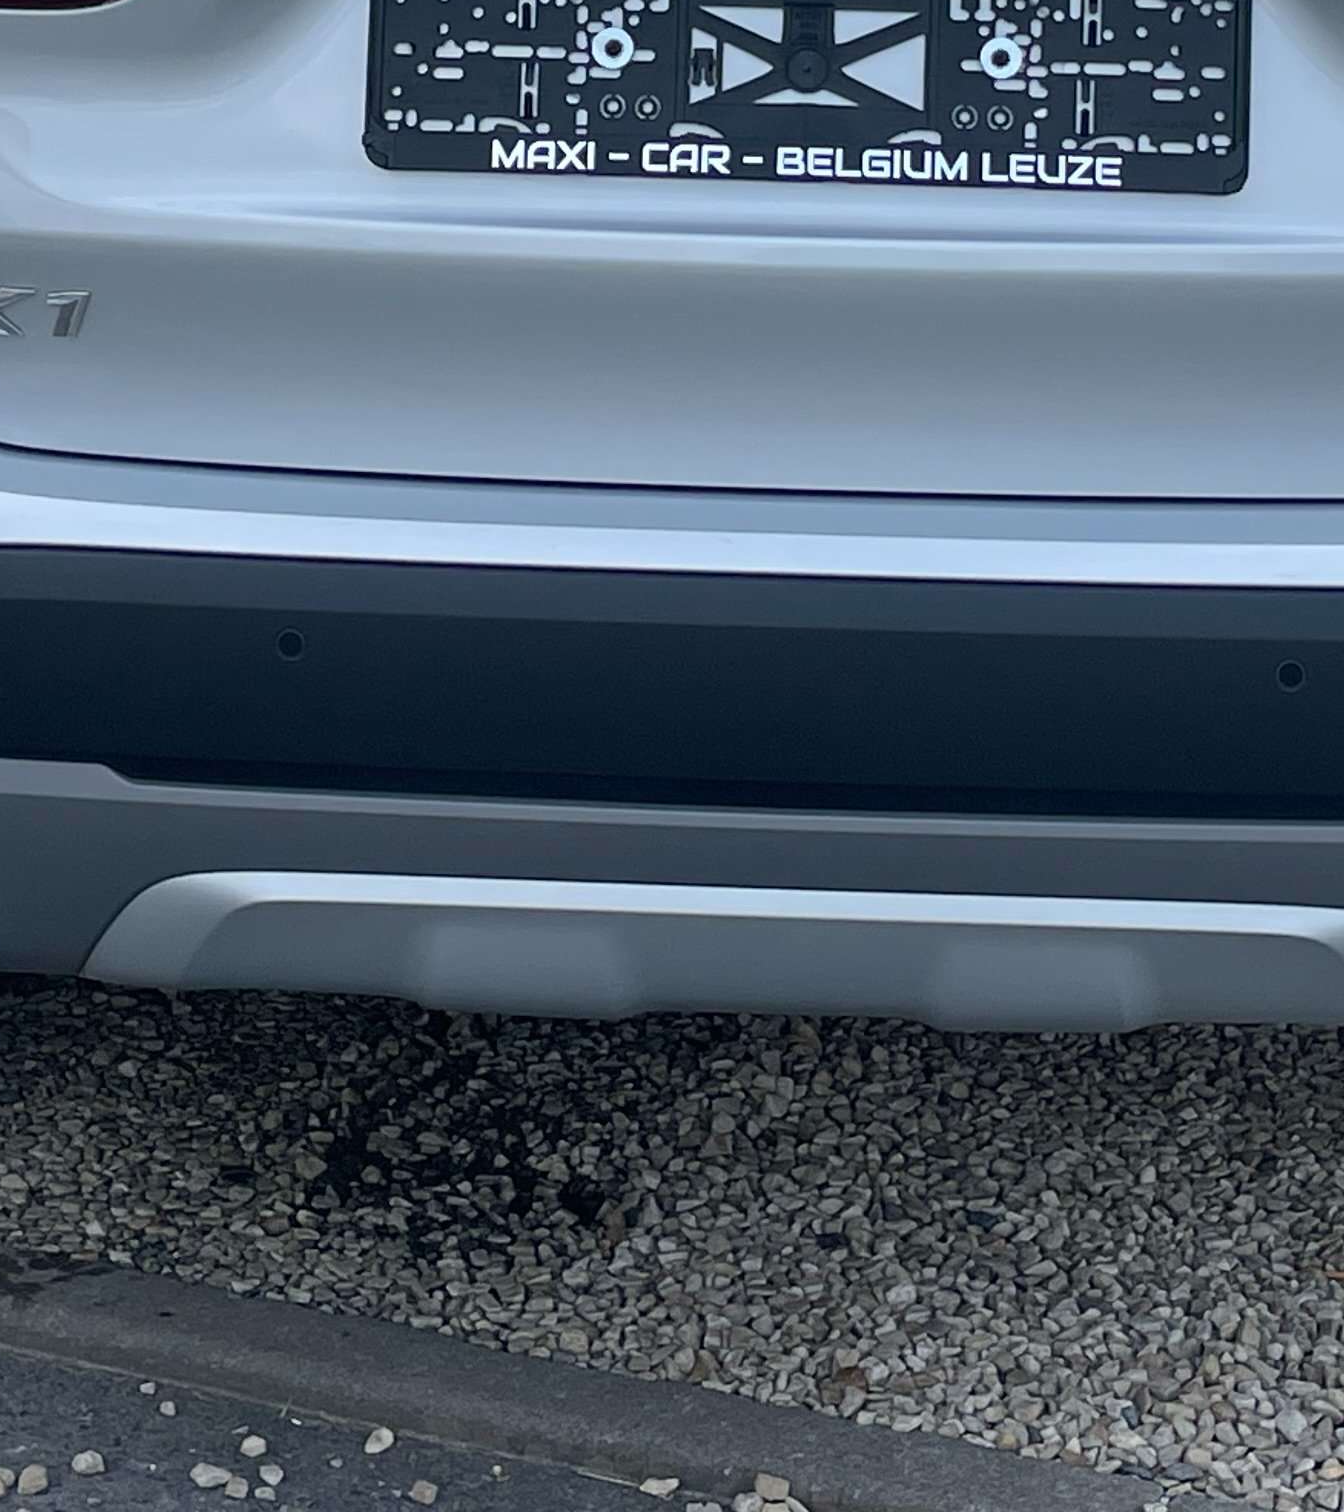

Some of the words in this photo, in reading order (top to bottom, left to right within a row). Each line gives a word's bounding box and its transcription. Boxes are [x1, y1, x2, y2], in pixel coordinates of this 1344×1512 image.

[491, 138, 596, 170] MAXI
[641, 141, 731, 174] CAR
[776, 146, 968, 182] BELGIUM
[981, 152, 1123, 187] LEUZE
